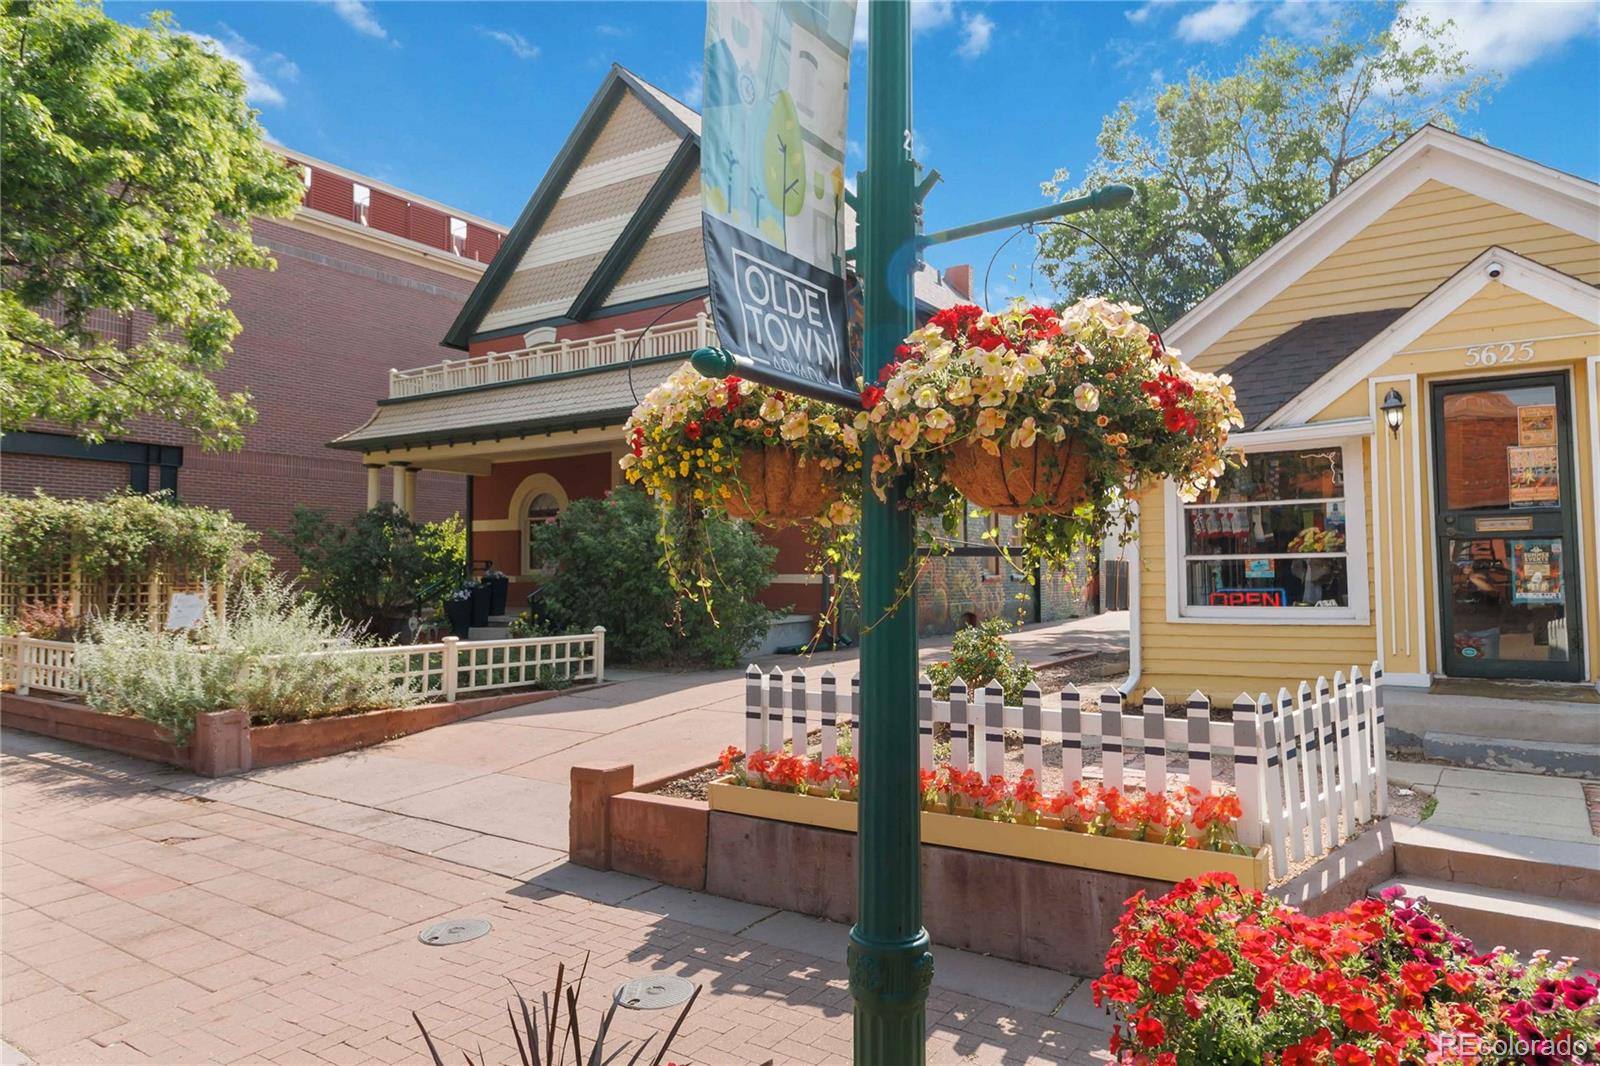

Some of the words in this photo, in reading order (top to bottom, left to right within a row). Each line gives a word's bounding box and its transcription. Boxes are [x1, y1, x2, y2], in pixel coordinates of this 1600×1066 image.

[744, 265, 823, 328] OLDE
[744, 303, 836, 369] TOWN
[1465, 341, 1535, 366] 5625
[1209, 591, 1281, 606] OPEN
